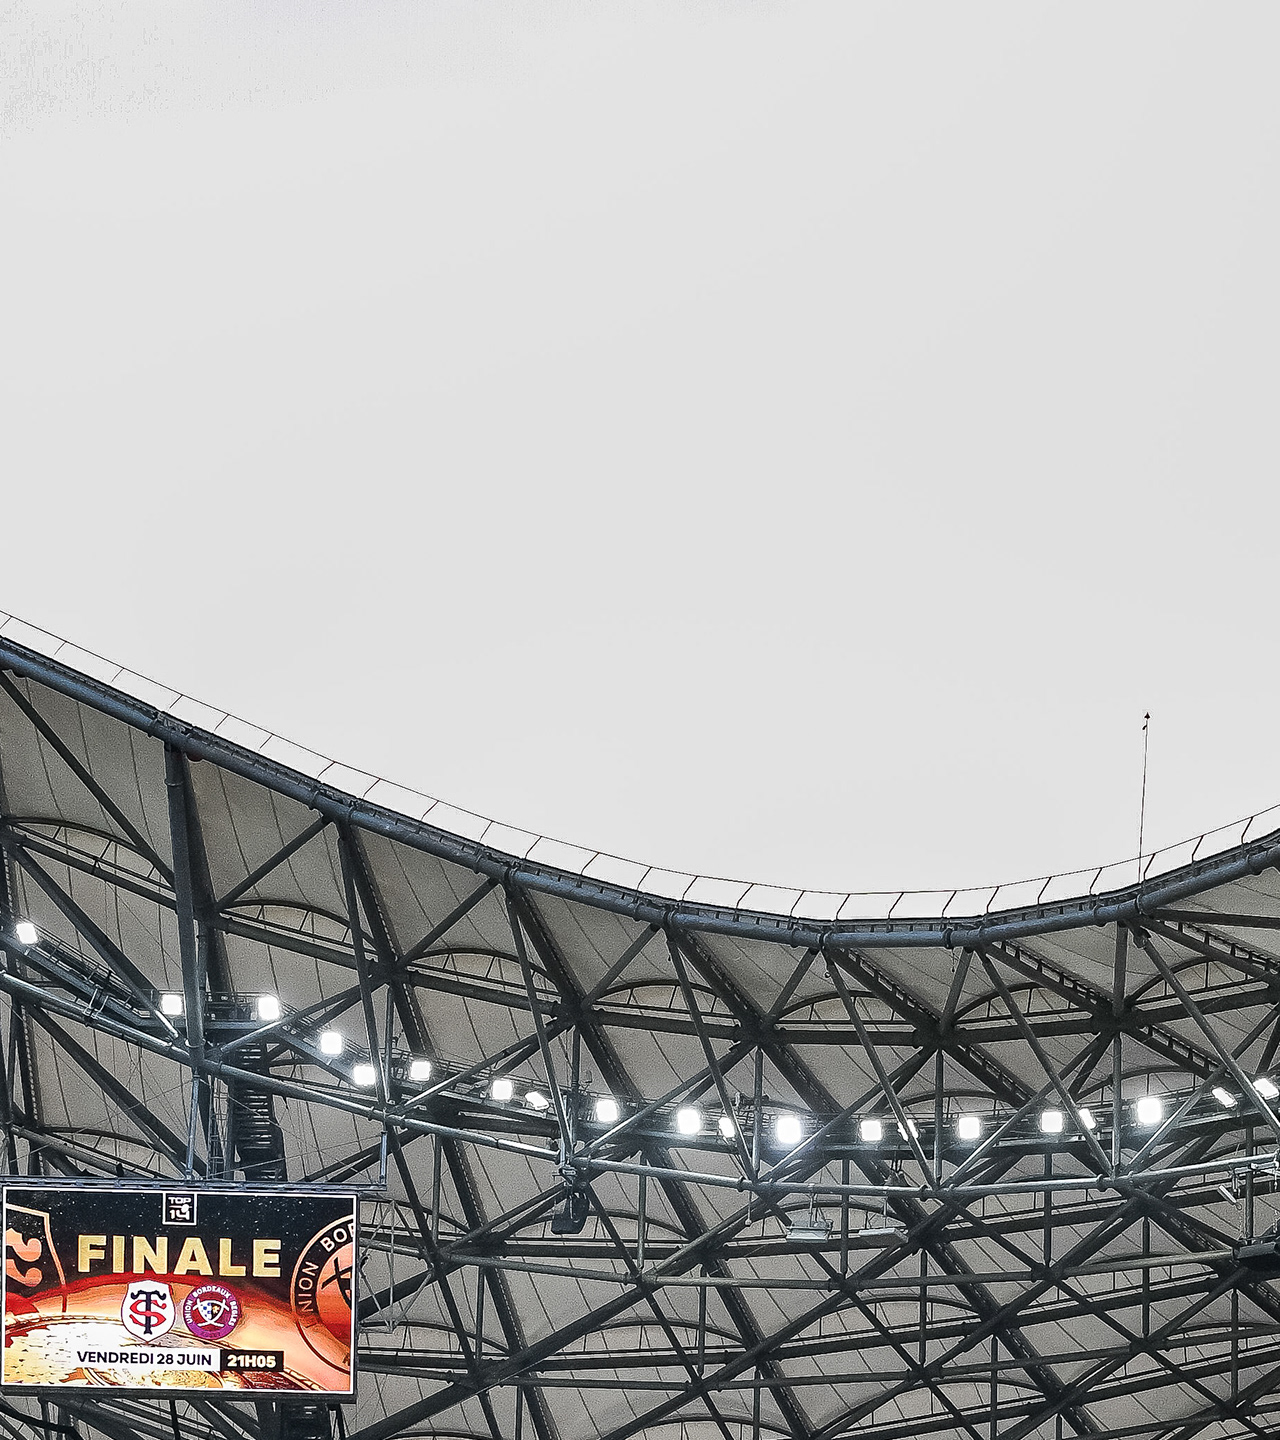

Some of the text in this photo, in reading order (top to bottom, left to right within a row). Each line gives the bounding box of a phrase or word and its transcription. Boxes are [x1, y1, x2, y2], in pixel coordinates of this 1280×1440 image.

[168, 1196, 191, 1204] TOP
[78, 1234, 281, 1277] FINALE
[184, 1299, 194, 1324] UNION
[192, 1285, 231, 1299] BORDEAUX
[77, 1351, 212, 1366] VENDREDI 28 JUIN
[227, 1354, 277, 1369] 21H05
